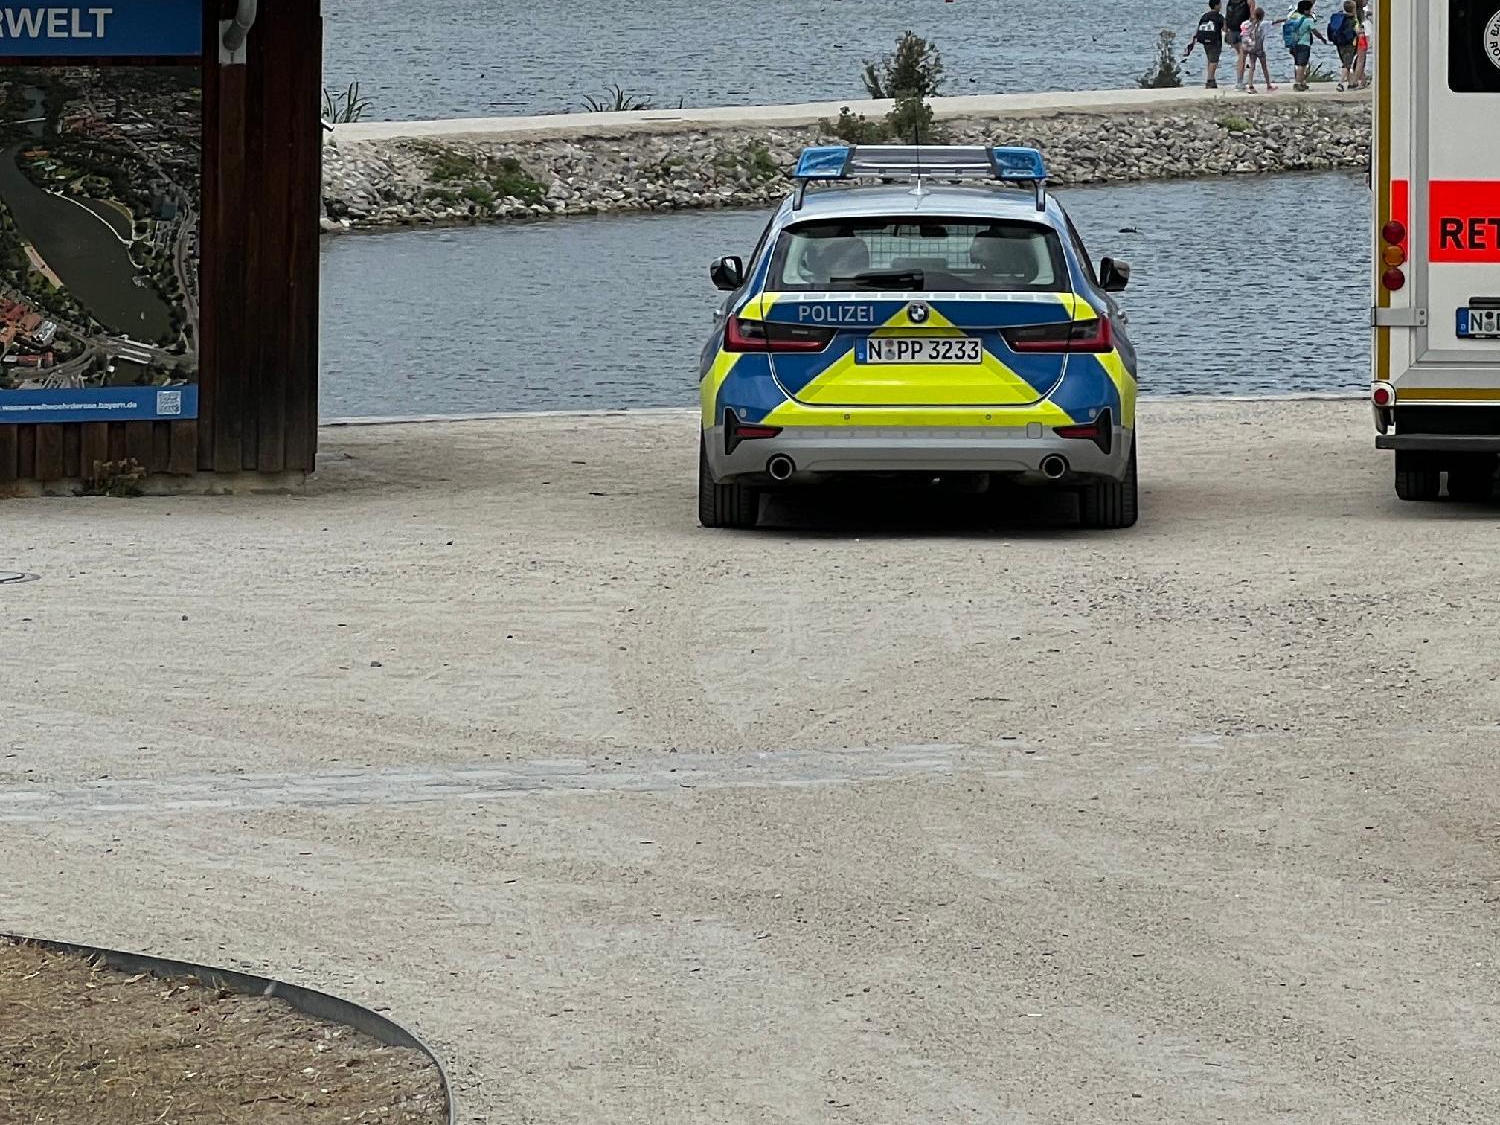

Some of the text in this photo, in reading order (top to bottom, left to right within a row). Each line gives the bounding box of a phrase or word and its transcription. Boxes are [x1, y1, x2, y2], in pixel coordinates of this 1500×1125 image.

[0, 7, 113, 38] WELT
[798, 305, 874, 322] POLIZEI
[1470, 312, 1483, 331] N
[868, 340, 882, 360] N
[897, 341, 923, 360] PP
[928, 341, 979, 360] 3233
